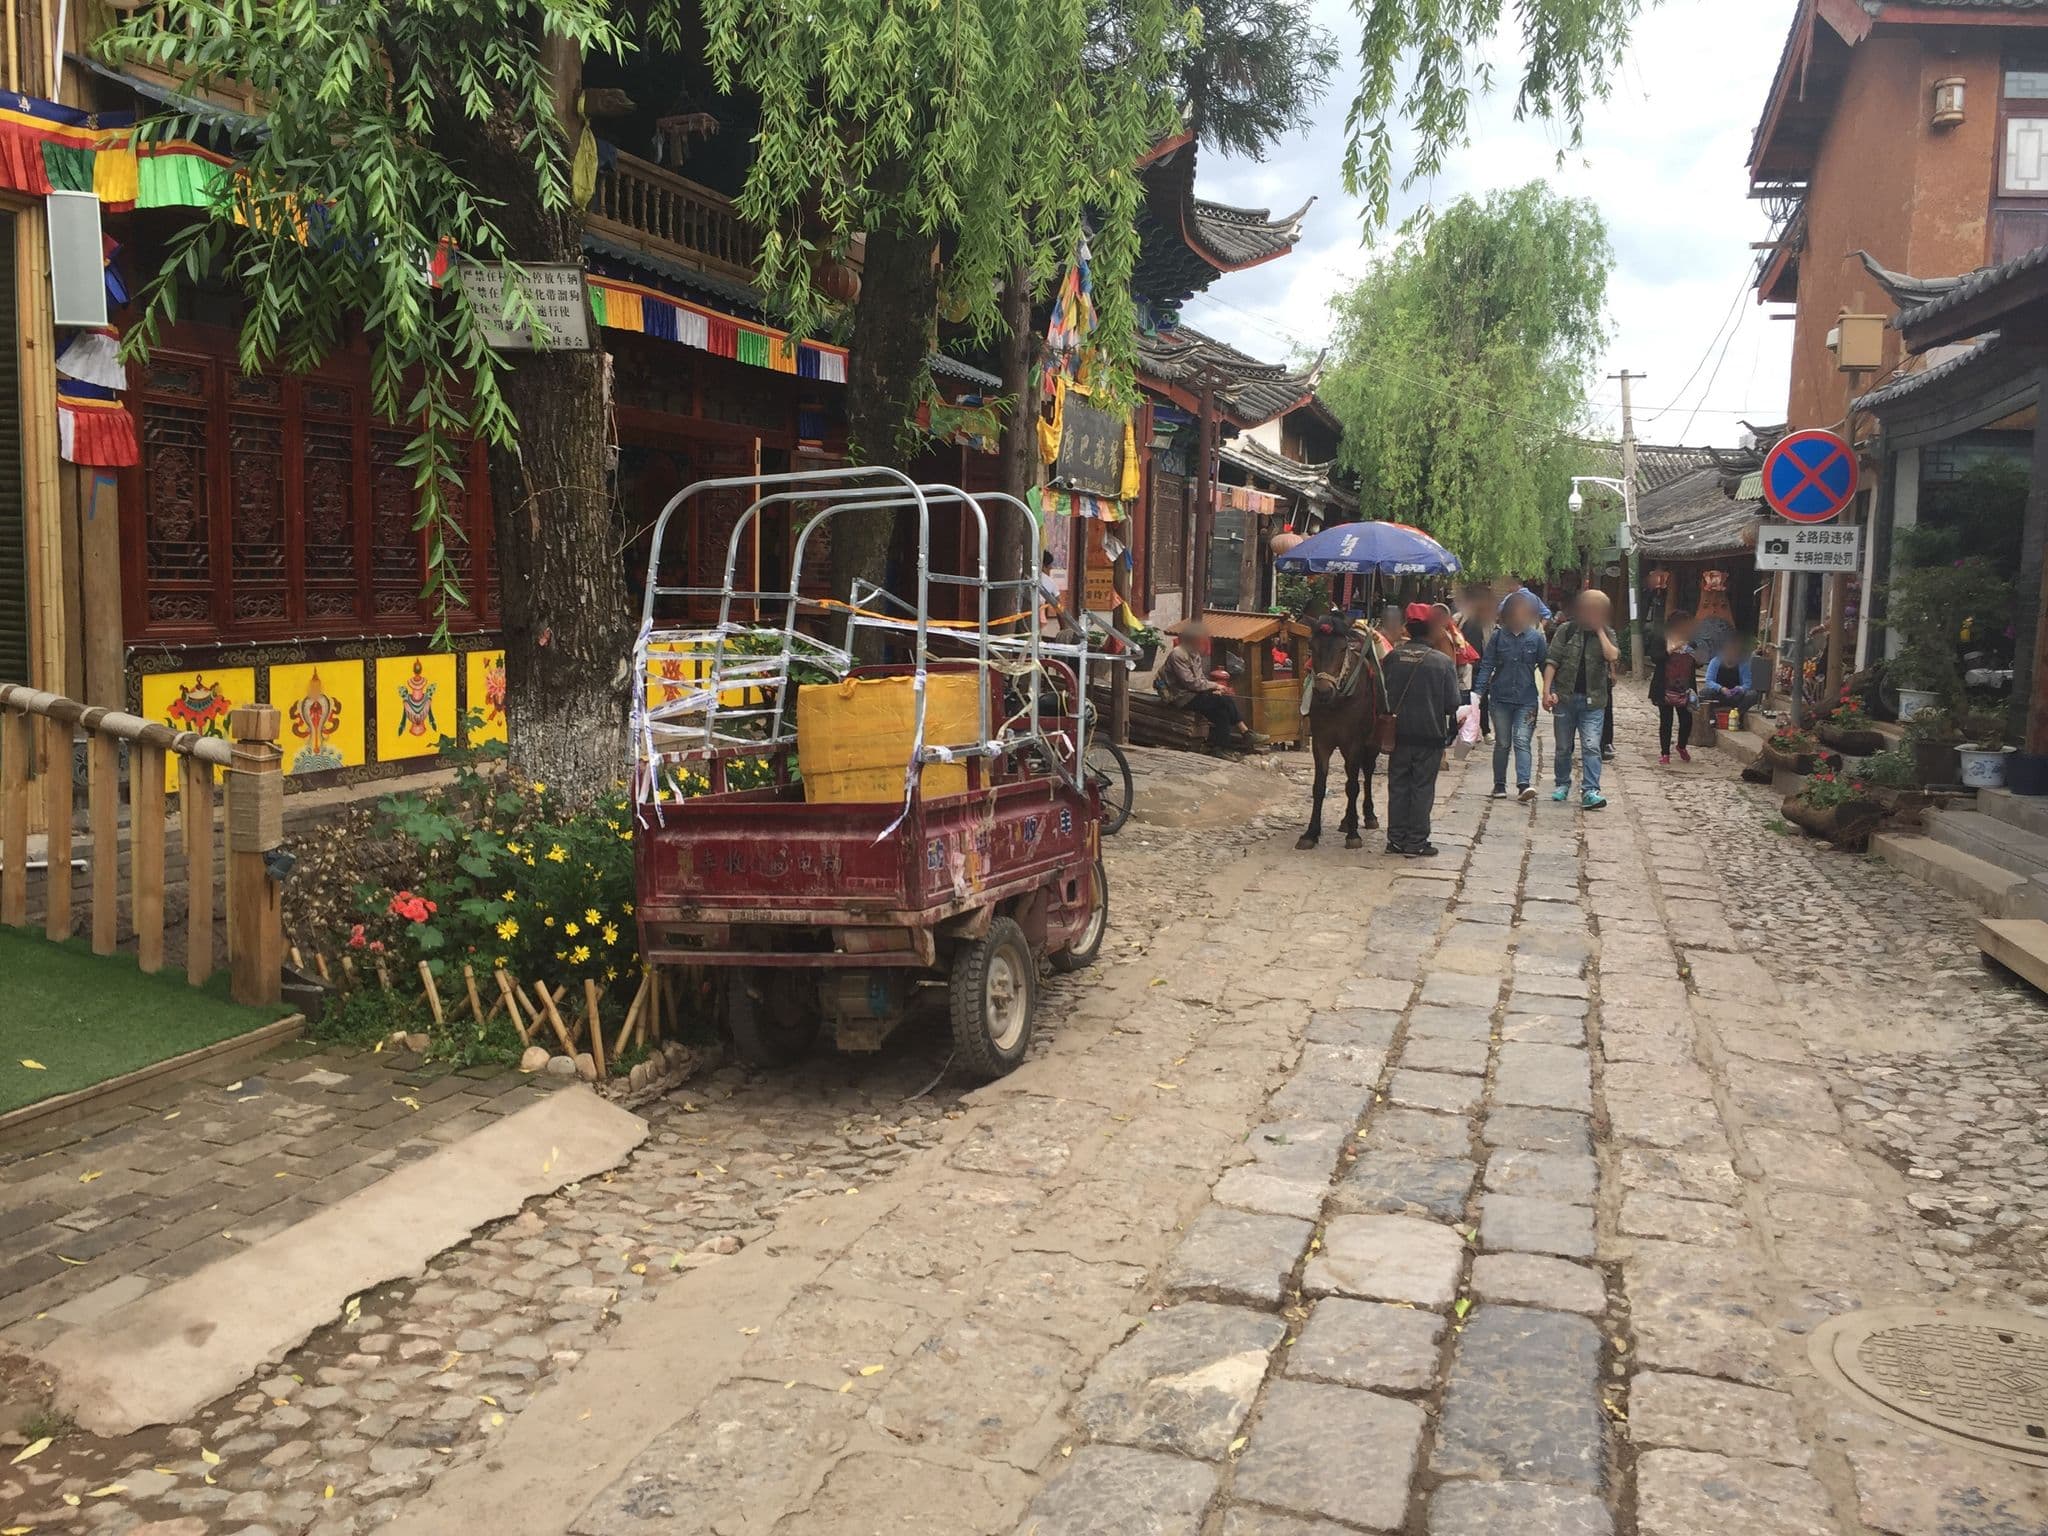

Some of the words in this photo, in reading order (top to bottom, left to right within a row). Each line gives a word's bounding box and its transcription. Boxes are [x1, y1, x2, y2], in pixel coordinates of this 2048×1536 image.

[1795, 530, 1855, 545] 全路段违停
[1793, 551, 1853, 566] 车辆拍照处罚
